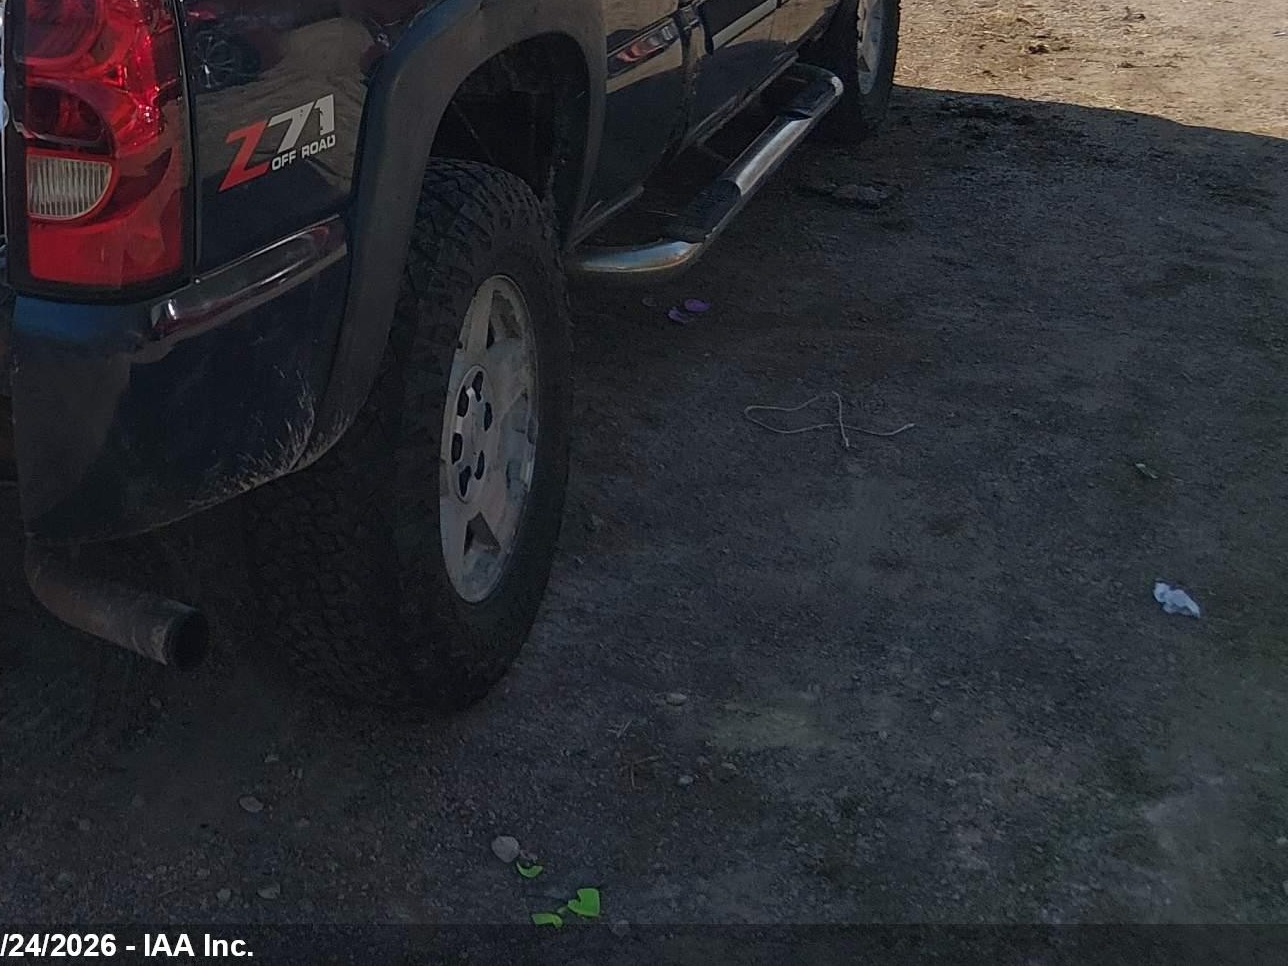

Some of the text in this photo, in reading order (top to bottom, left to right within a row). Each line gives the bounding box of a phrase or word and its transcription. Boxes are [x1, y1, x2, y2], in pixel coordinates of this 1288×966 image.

[218, 94, 335, 192] Z71
[272, 134, 336, 171] OFF ROAD
